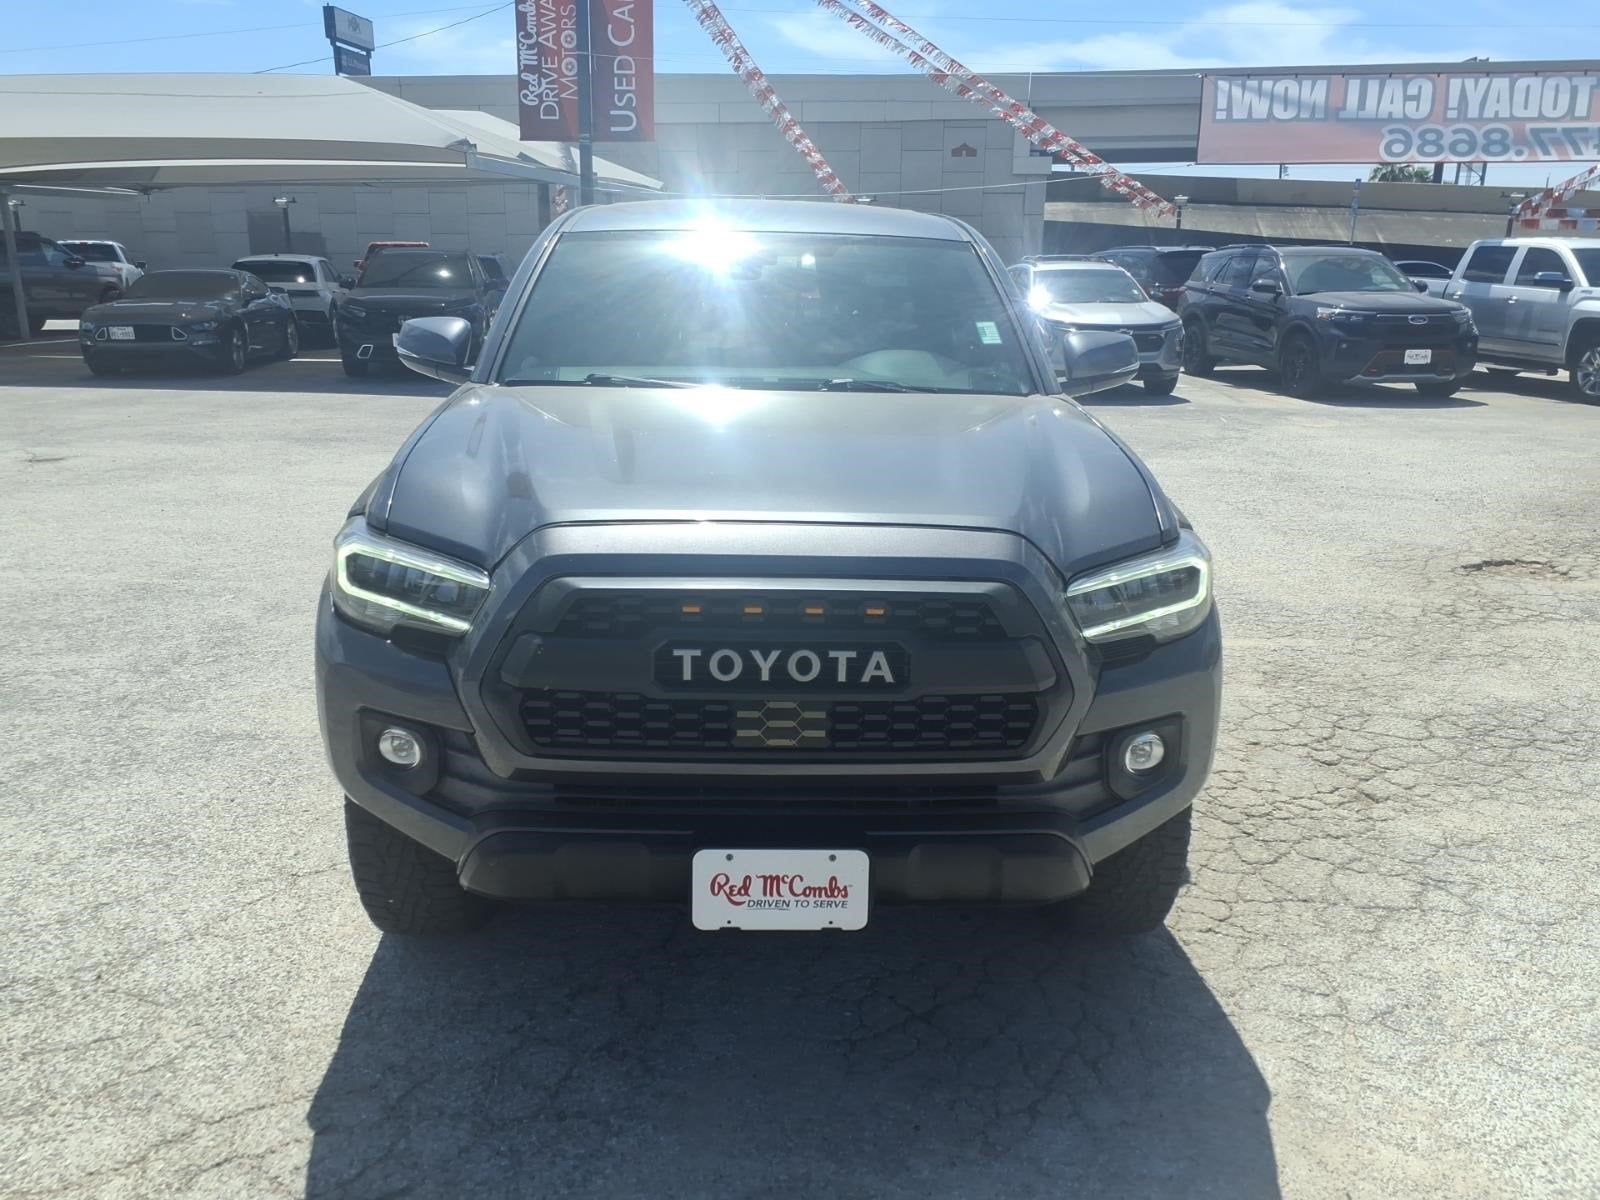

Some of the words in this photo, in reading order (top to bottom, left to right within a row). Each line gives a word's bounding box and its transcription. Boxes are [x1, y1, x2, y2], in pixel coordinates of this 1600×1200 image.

[518, 0, 538, 69] McComb
[607, 0, 636, 47] CA
[559, 4, 579, 99] MOTORS
[519, 72, 547, 106] Red
[539, 55, 560, 120] DRIVE
[608, 55, 638, 132] USED
[672, 648, 896, 683] TOYOTA
[709, 872, 752, 906] Red
[756, 874, 849, 899] McCombs
[747, 898, 791, 909] DRIVEN
[794, 899, 810, 909] TO
[812, 899, 849, 910] SERVE
